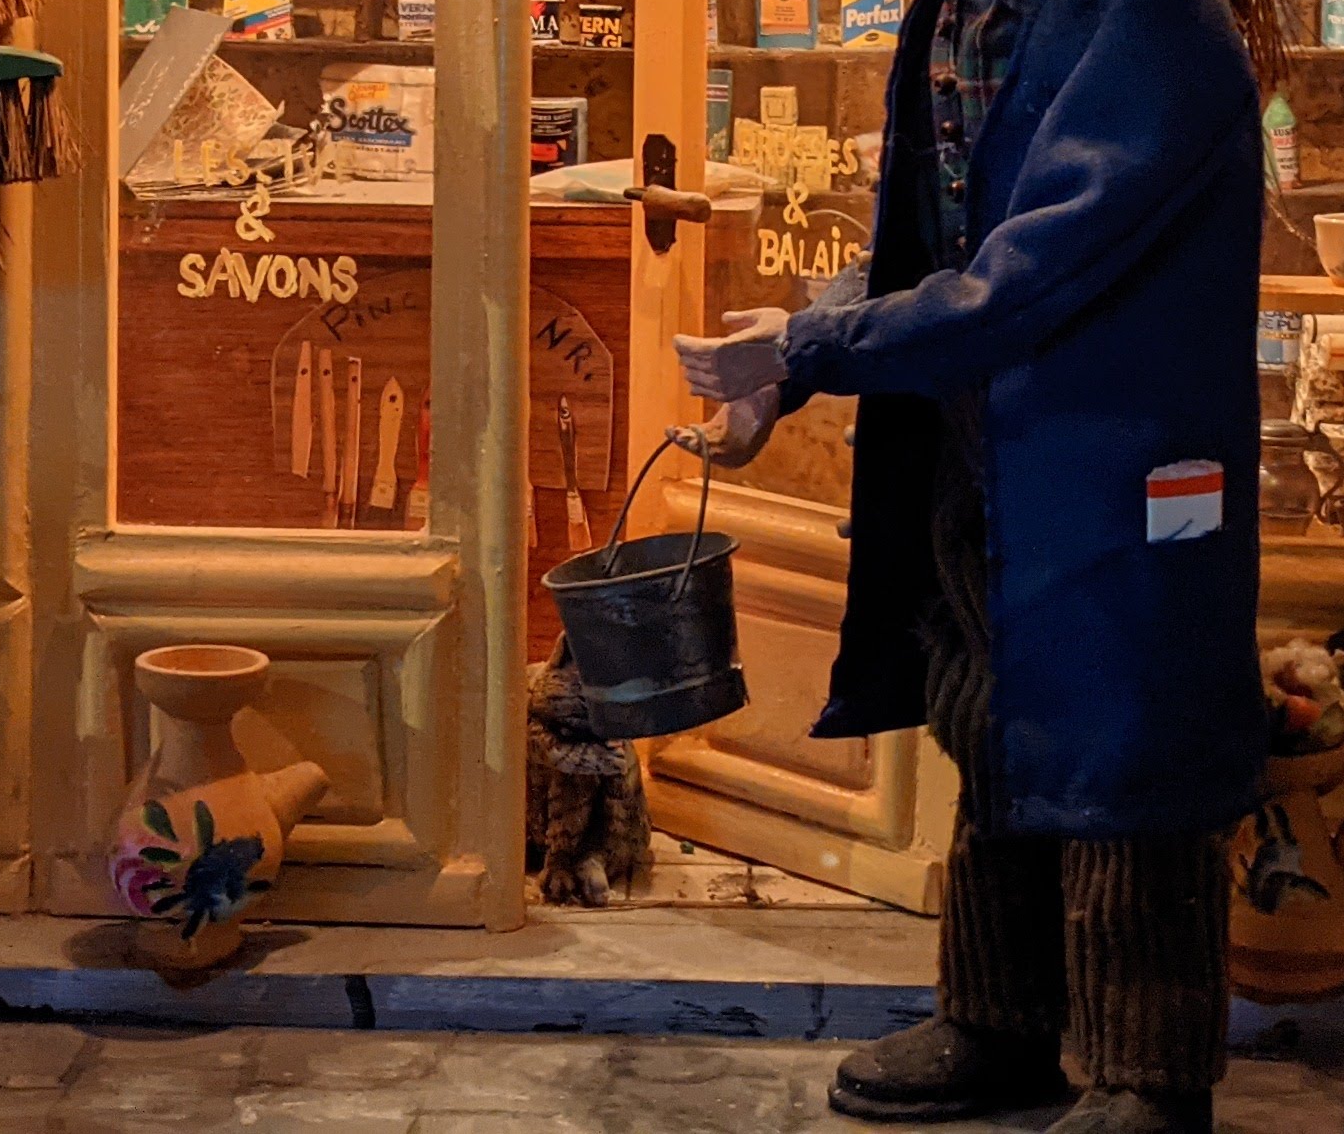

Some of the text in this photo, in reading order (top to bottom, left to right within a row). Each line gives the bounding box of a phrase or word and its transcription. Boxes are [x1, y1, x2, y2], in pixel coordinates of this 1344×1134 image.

[845, 4, 900, 28] Perfax
[325, 97, 416, 136] Scottex
[235, 187, 275, 243] &
[783, 182, 809, 228] &
[176, 248, 358, 304] SAVONS
